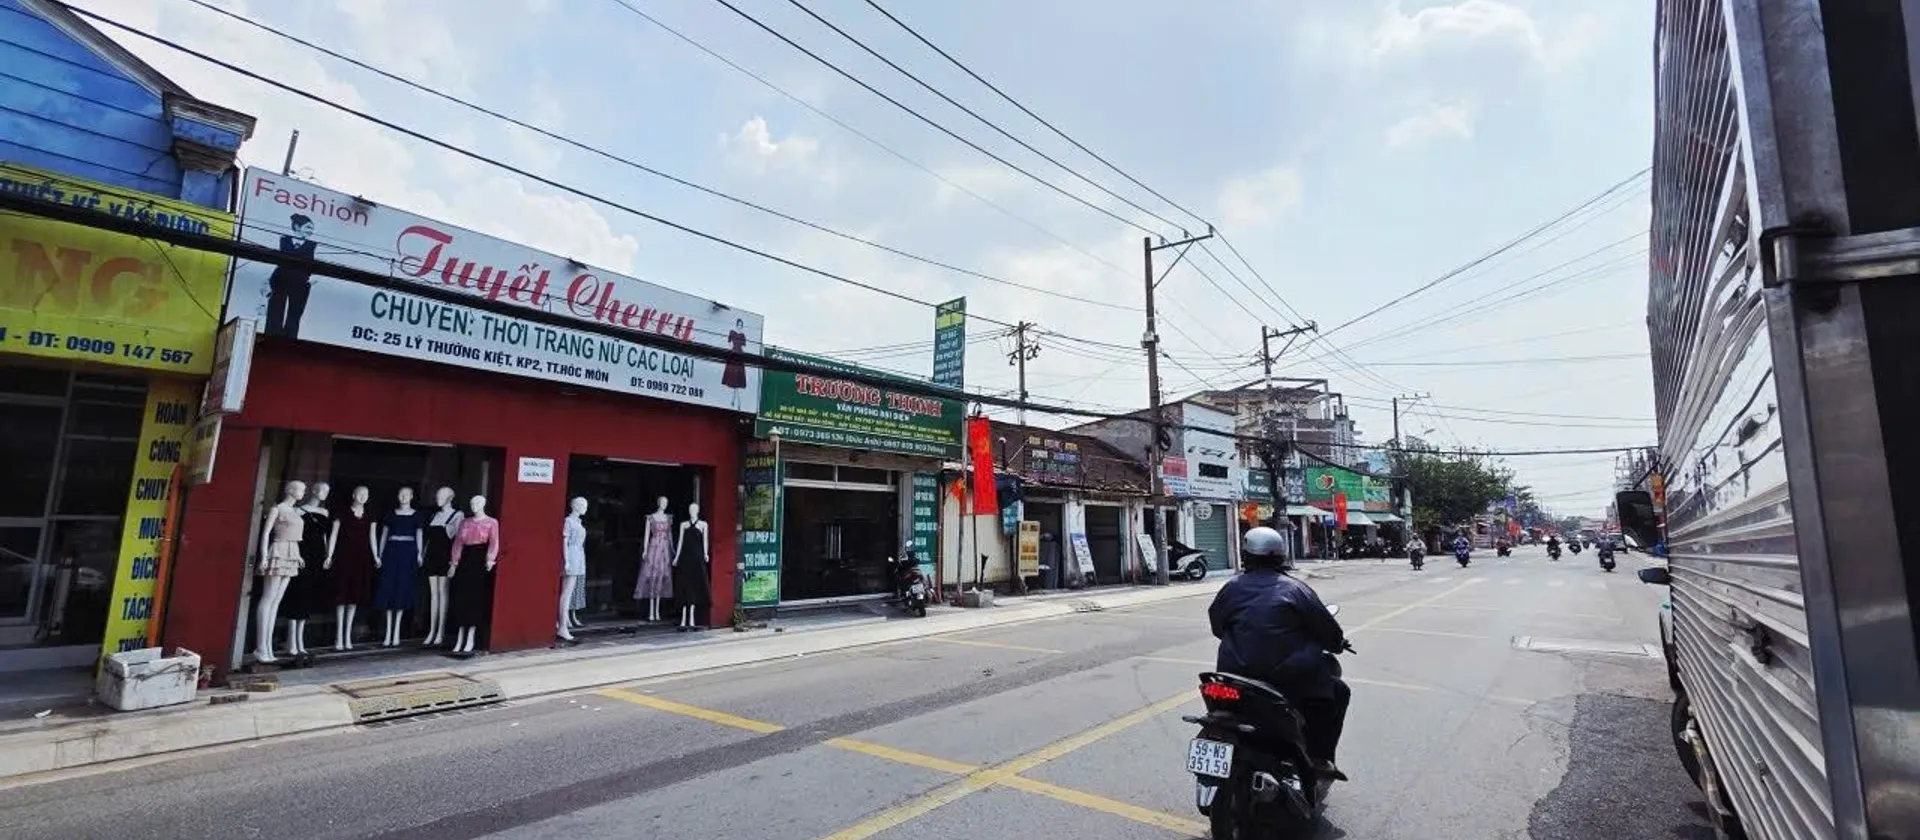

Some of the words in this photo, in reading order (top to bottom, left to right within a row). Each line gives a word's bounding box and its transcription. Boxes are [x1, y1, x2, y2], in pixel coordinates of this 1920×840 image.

[254, 178, 370, 227] Fashion
[397, 225, 551, 306] Tuyết
[66, 335, 115, 356] 0909
[122, 343, 155, 361] 147
[160, 348, 193, 365] 567
[351, 325, 379, 343] ĐC:
[382, 331, 402, 346] 25
[405, 334, 422, 350] LÝ
[534, 326, 594, 360] TRANG
[662, 353, 695, 382] LOẠI
[136, 477, 173, 501] CHUY
[1189, 756, 1229, 776] 351.59
